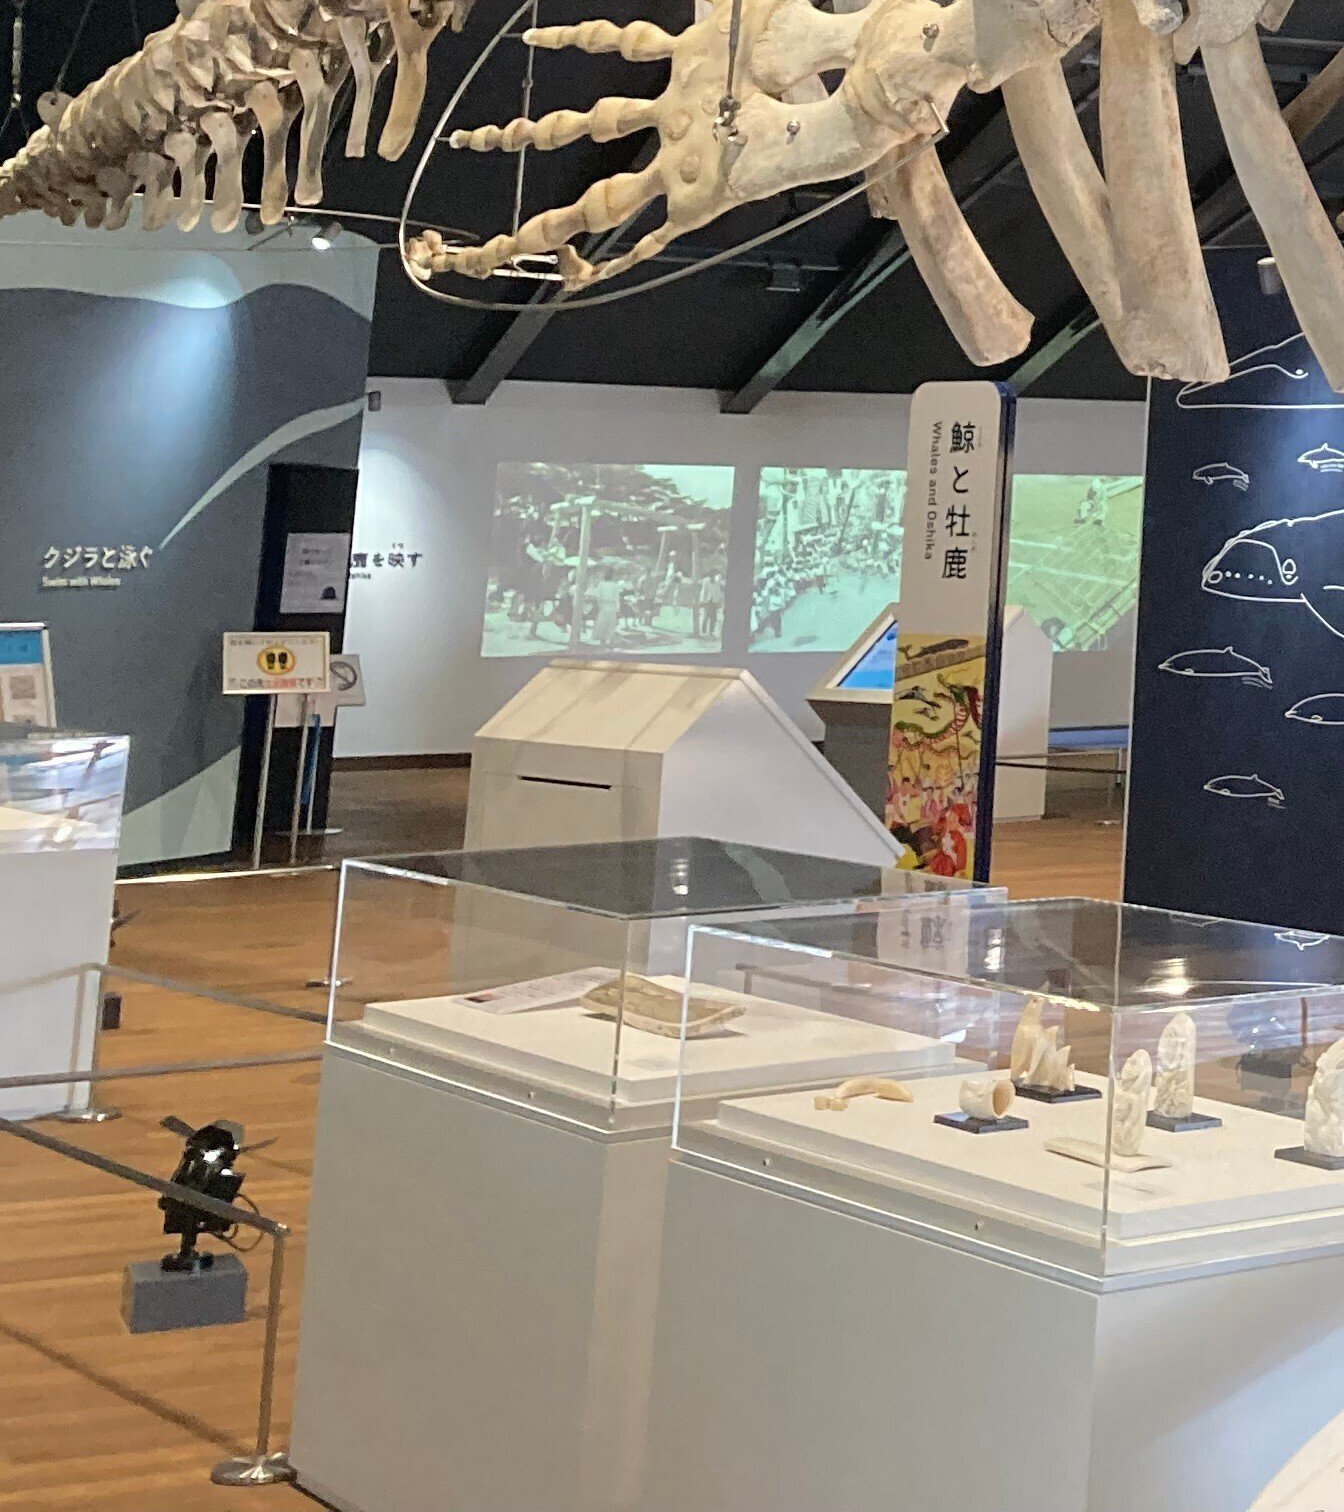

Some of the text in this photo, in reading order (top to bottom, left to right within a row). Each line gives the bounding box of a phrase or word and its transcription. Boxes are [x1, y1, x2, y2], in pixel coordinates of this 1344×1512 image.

[43, 544, 154, 570] クジラと泳ぐ
[924, 420, 943, 561] Whales and Oshika
[941, 420, 976, 580] 鯨と牡鹿
